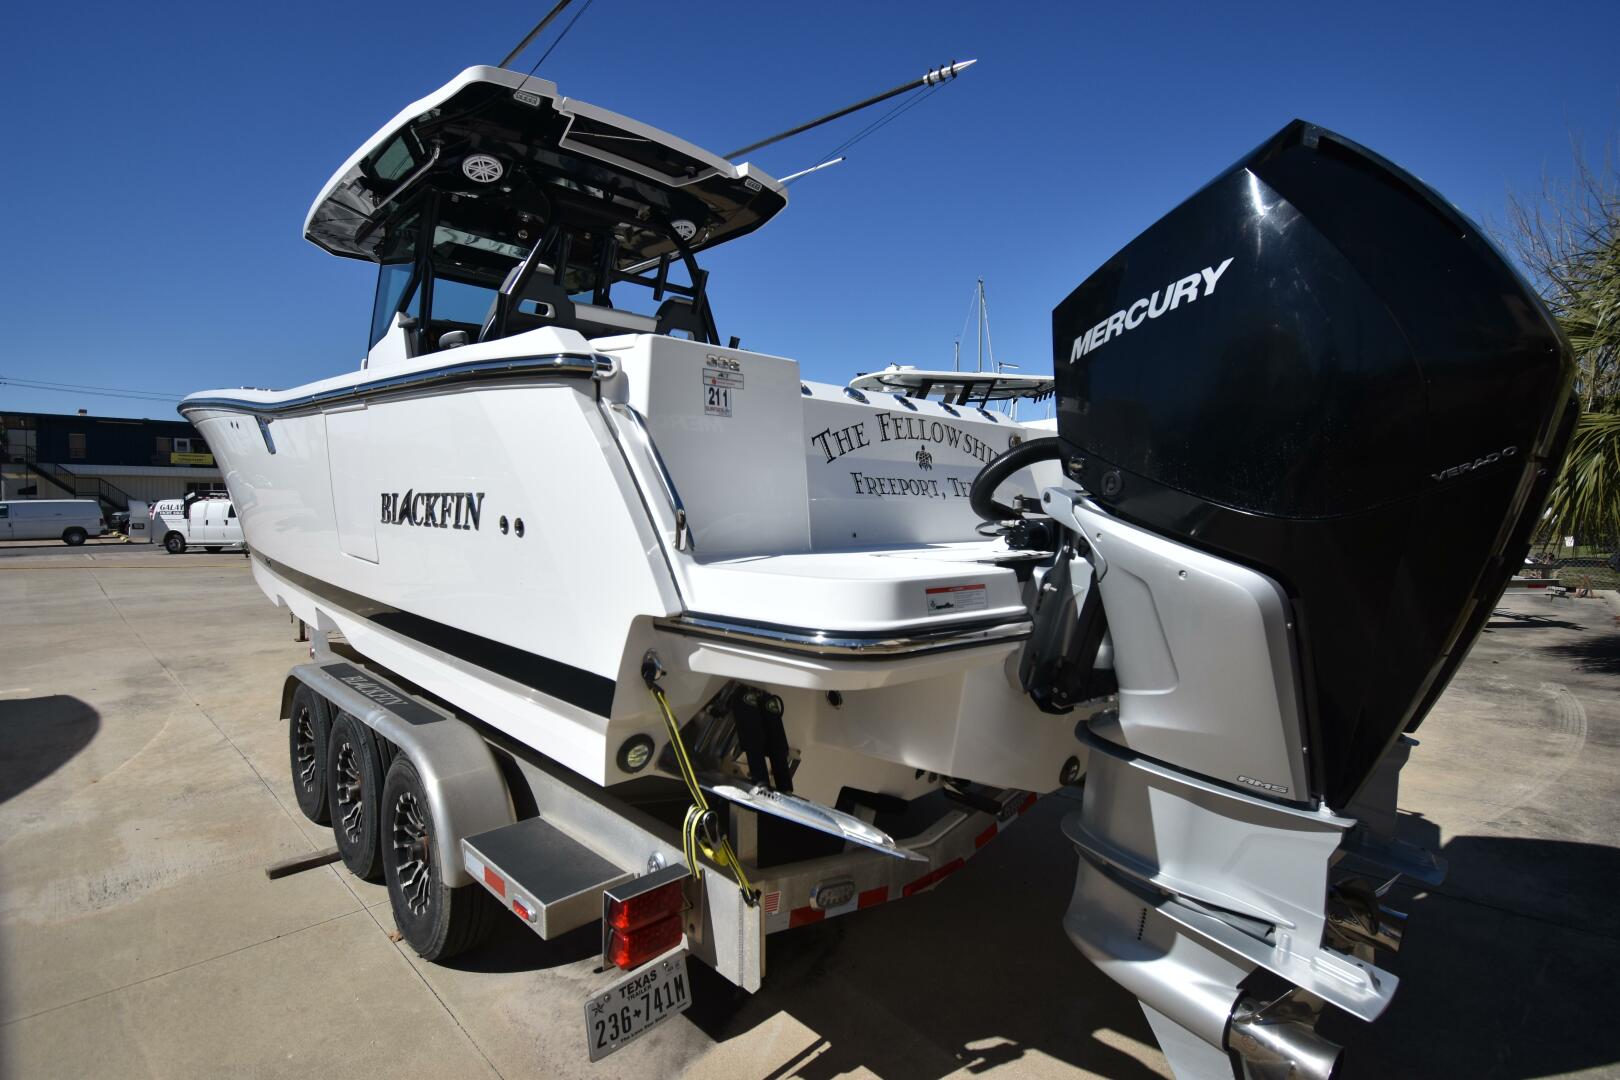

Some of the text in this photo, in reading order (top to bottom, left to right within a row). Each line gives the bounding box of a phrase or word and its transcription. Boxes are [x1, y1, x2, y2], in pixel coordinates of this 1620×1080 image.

[1069, 256, 1235, 365] MERCURY
[708, 387, 727, 408] 211
[811, 421, 871, 464] THE
[1431, 446, 1518, 481] VERADO
[850, 472, 972, 500] FREEPORT, TE
[381, 488, 485, 531] BLACKFIN
[340, 675, 409, 706] BLACKFIN
[1237, 775, 1288, 793] AMS
[619, 970, 657, 998] TEXAS
[627, 984, 652, 1001] TRAILER
